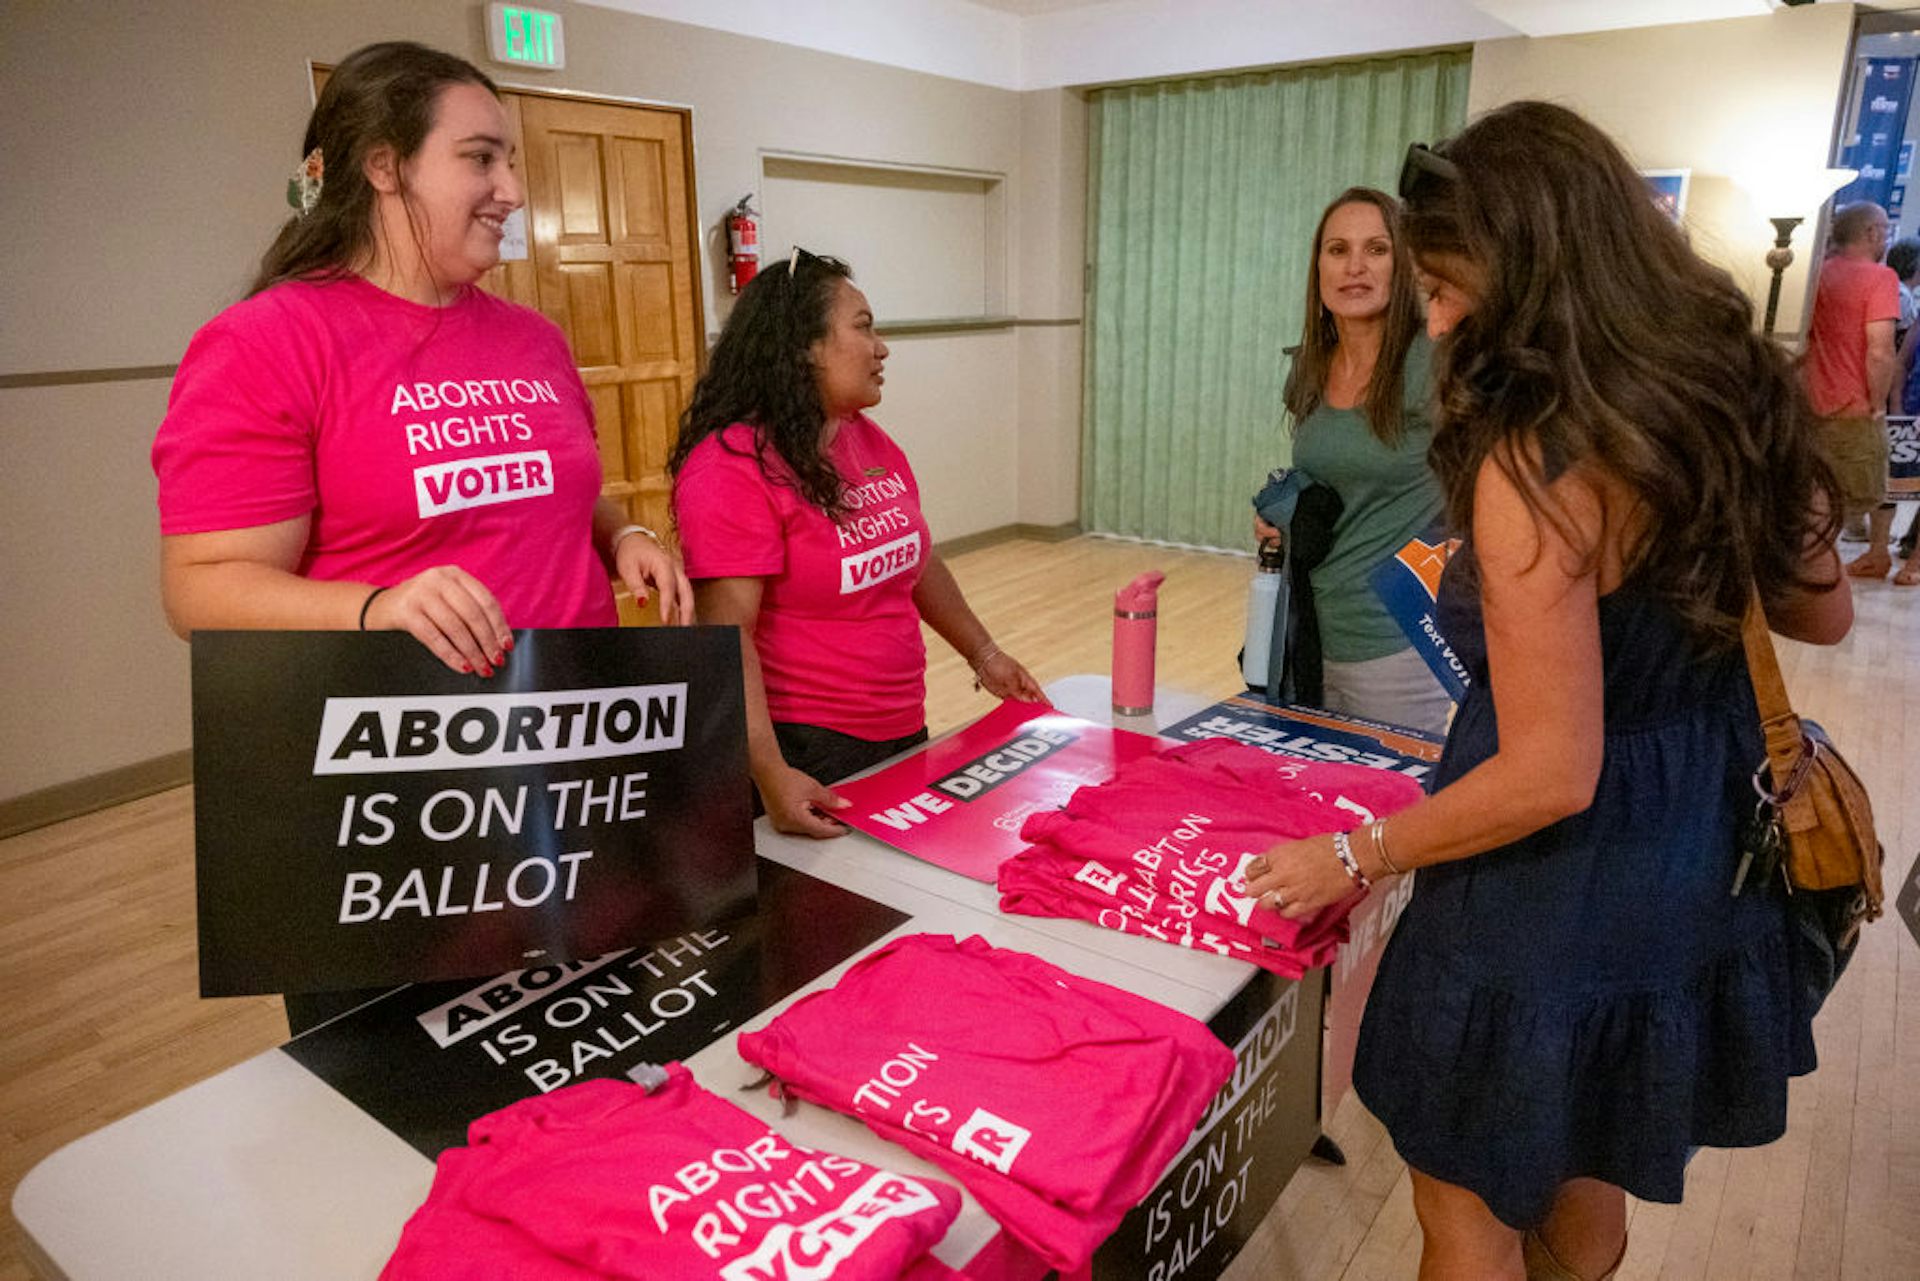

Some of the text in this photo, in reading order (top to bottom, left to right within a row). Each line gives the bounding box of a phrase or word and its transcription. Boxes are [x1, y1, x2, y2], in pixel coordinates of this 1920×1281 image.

[503, 7, 556, 65] EXIT
[391, 378, 560, 415] ABORTION
[405, 412, 533, 456] RIGHTS
[422, 459, 548, 507] VOTER
[849, 542, 916, 586] VOTER
[1418, 613, 1446, 647] Text
[329, 696, 678, 761] ABORTION
[1197, 715, 1432, 784] TESTER
[337, 772, 649, 847] IS ON THE
[868, 792, 954, 831] WE
[938, 727, 1071, 799] DECIDE
[338, 850, 594, 924] BALLOT
[480, 928, 730, 1066] IS ON THE
[523, 968, 718, 1094] BALLOT
[852, 1042, 939, 1110] TION
[1144, 1071, 1279, 1254] IS ON THE
[691, 1155, 862, 1259] RIGHTS
